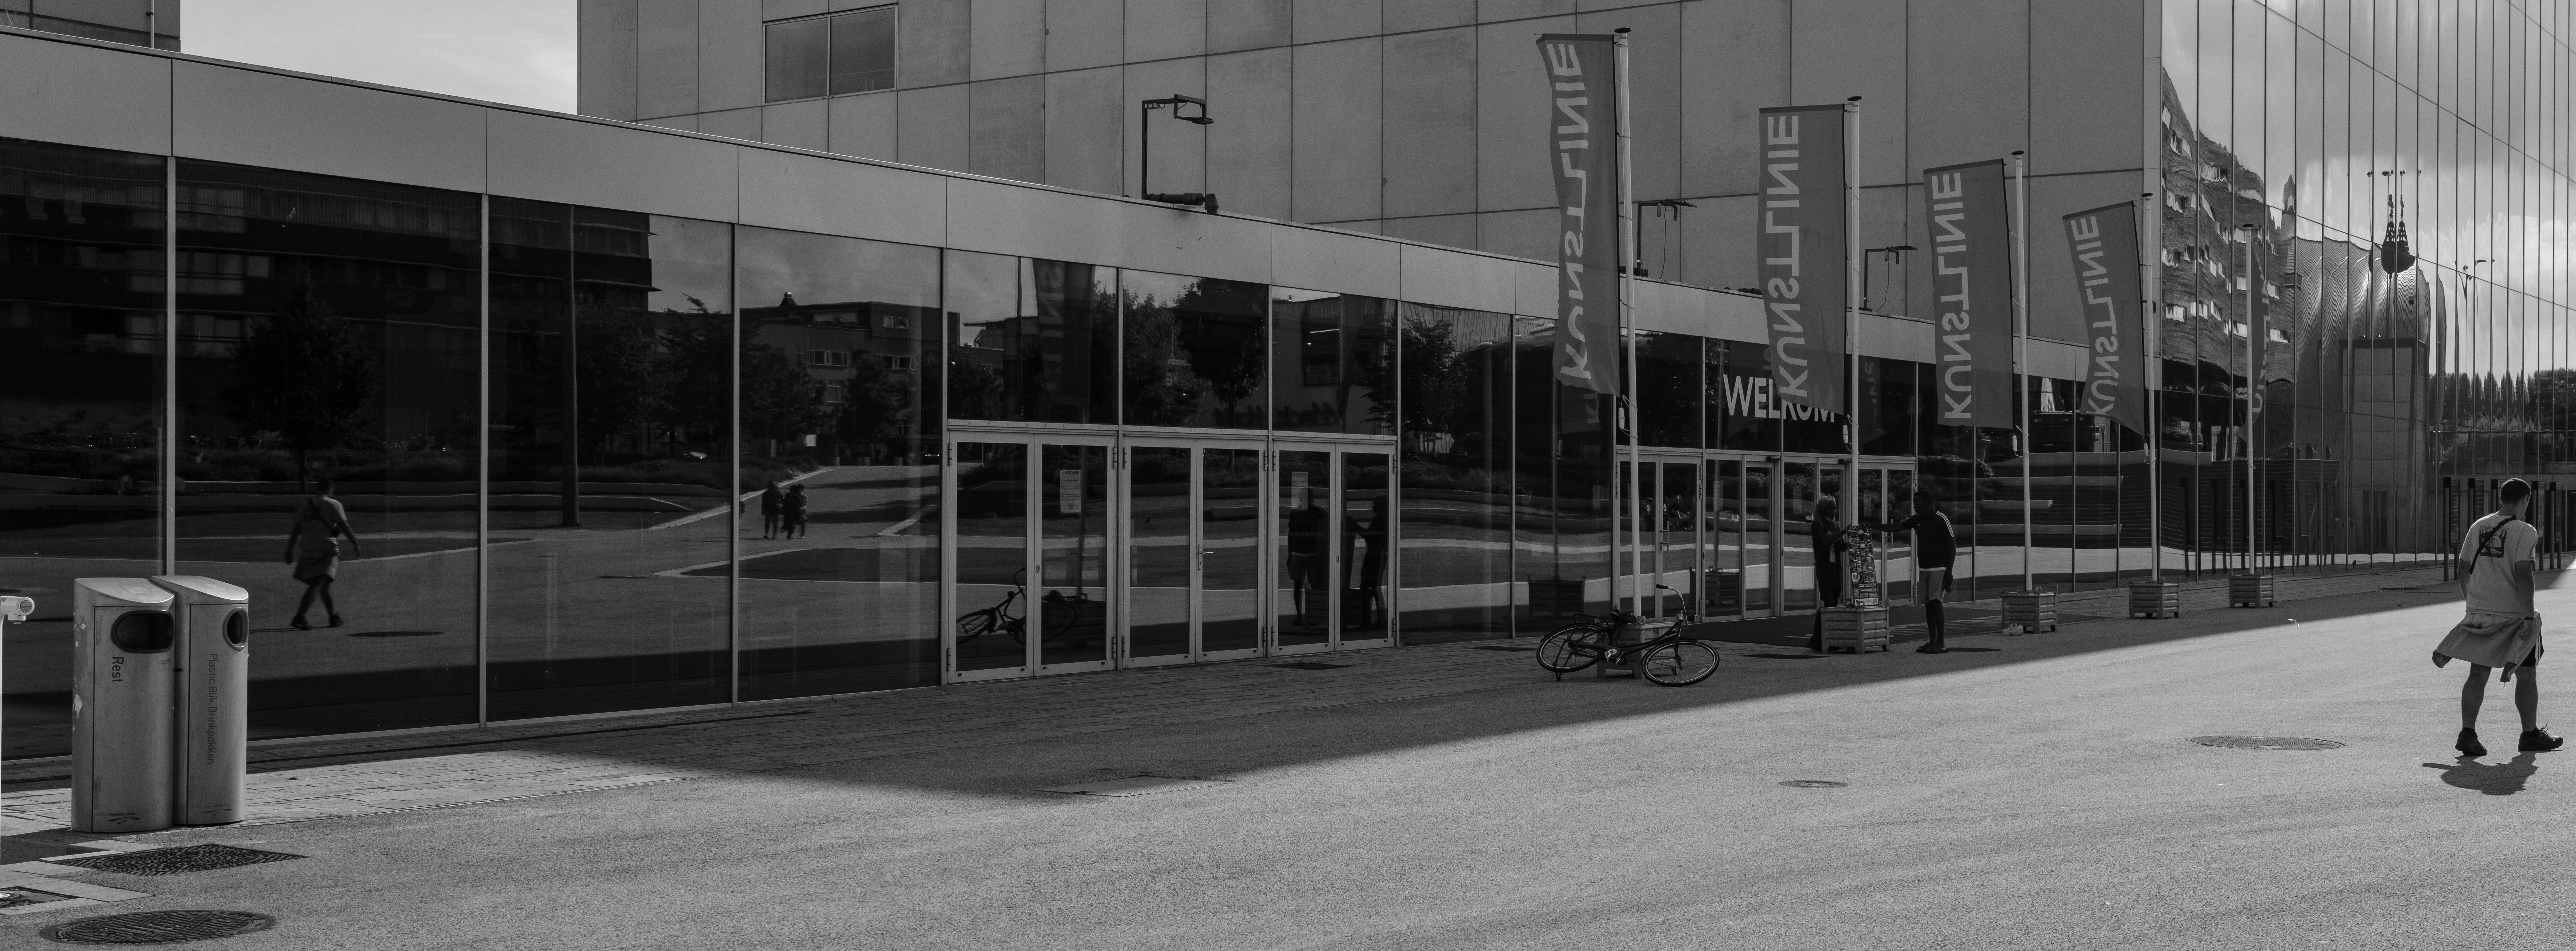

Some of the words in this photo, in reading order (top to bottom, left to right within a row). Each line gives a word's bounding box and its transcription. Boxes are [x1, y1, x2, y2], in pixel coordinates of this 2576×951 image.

[112, 657, 124, 682] Rest
[209, 653, 218, 683] Plastic
[208, 686, 217, 704] Blik
[206, 706, 217, 764] Drinkpakken
